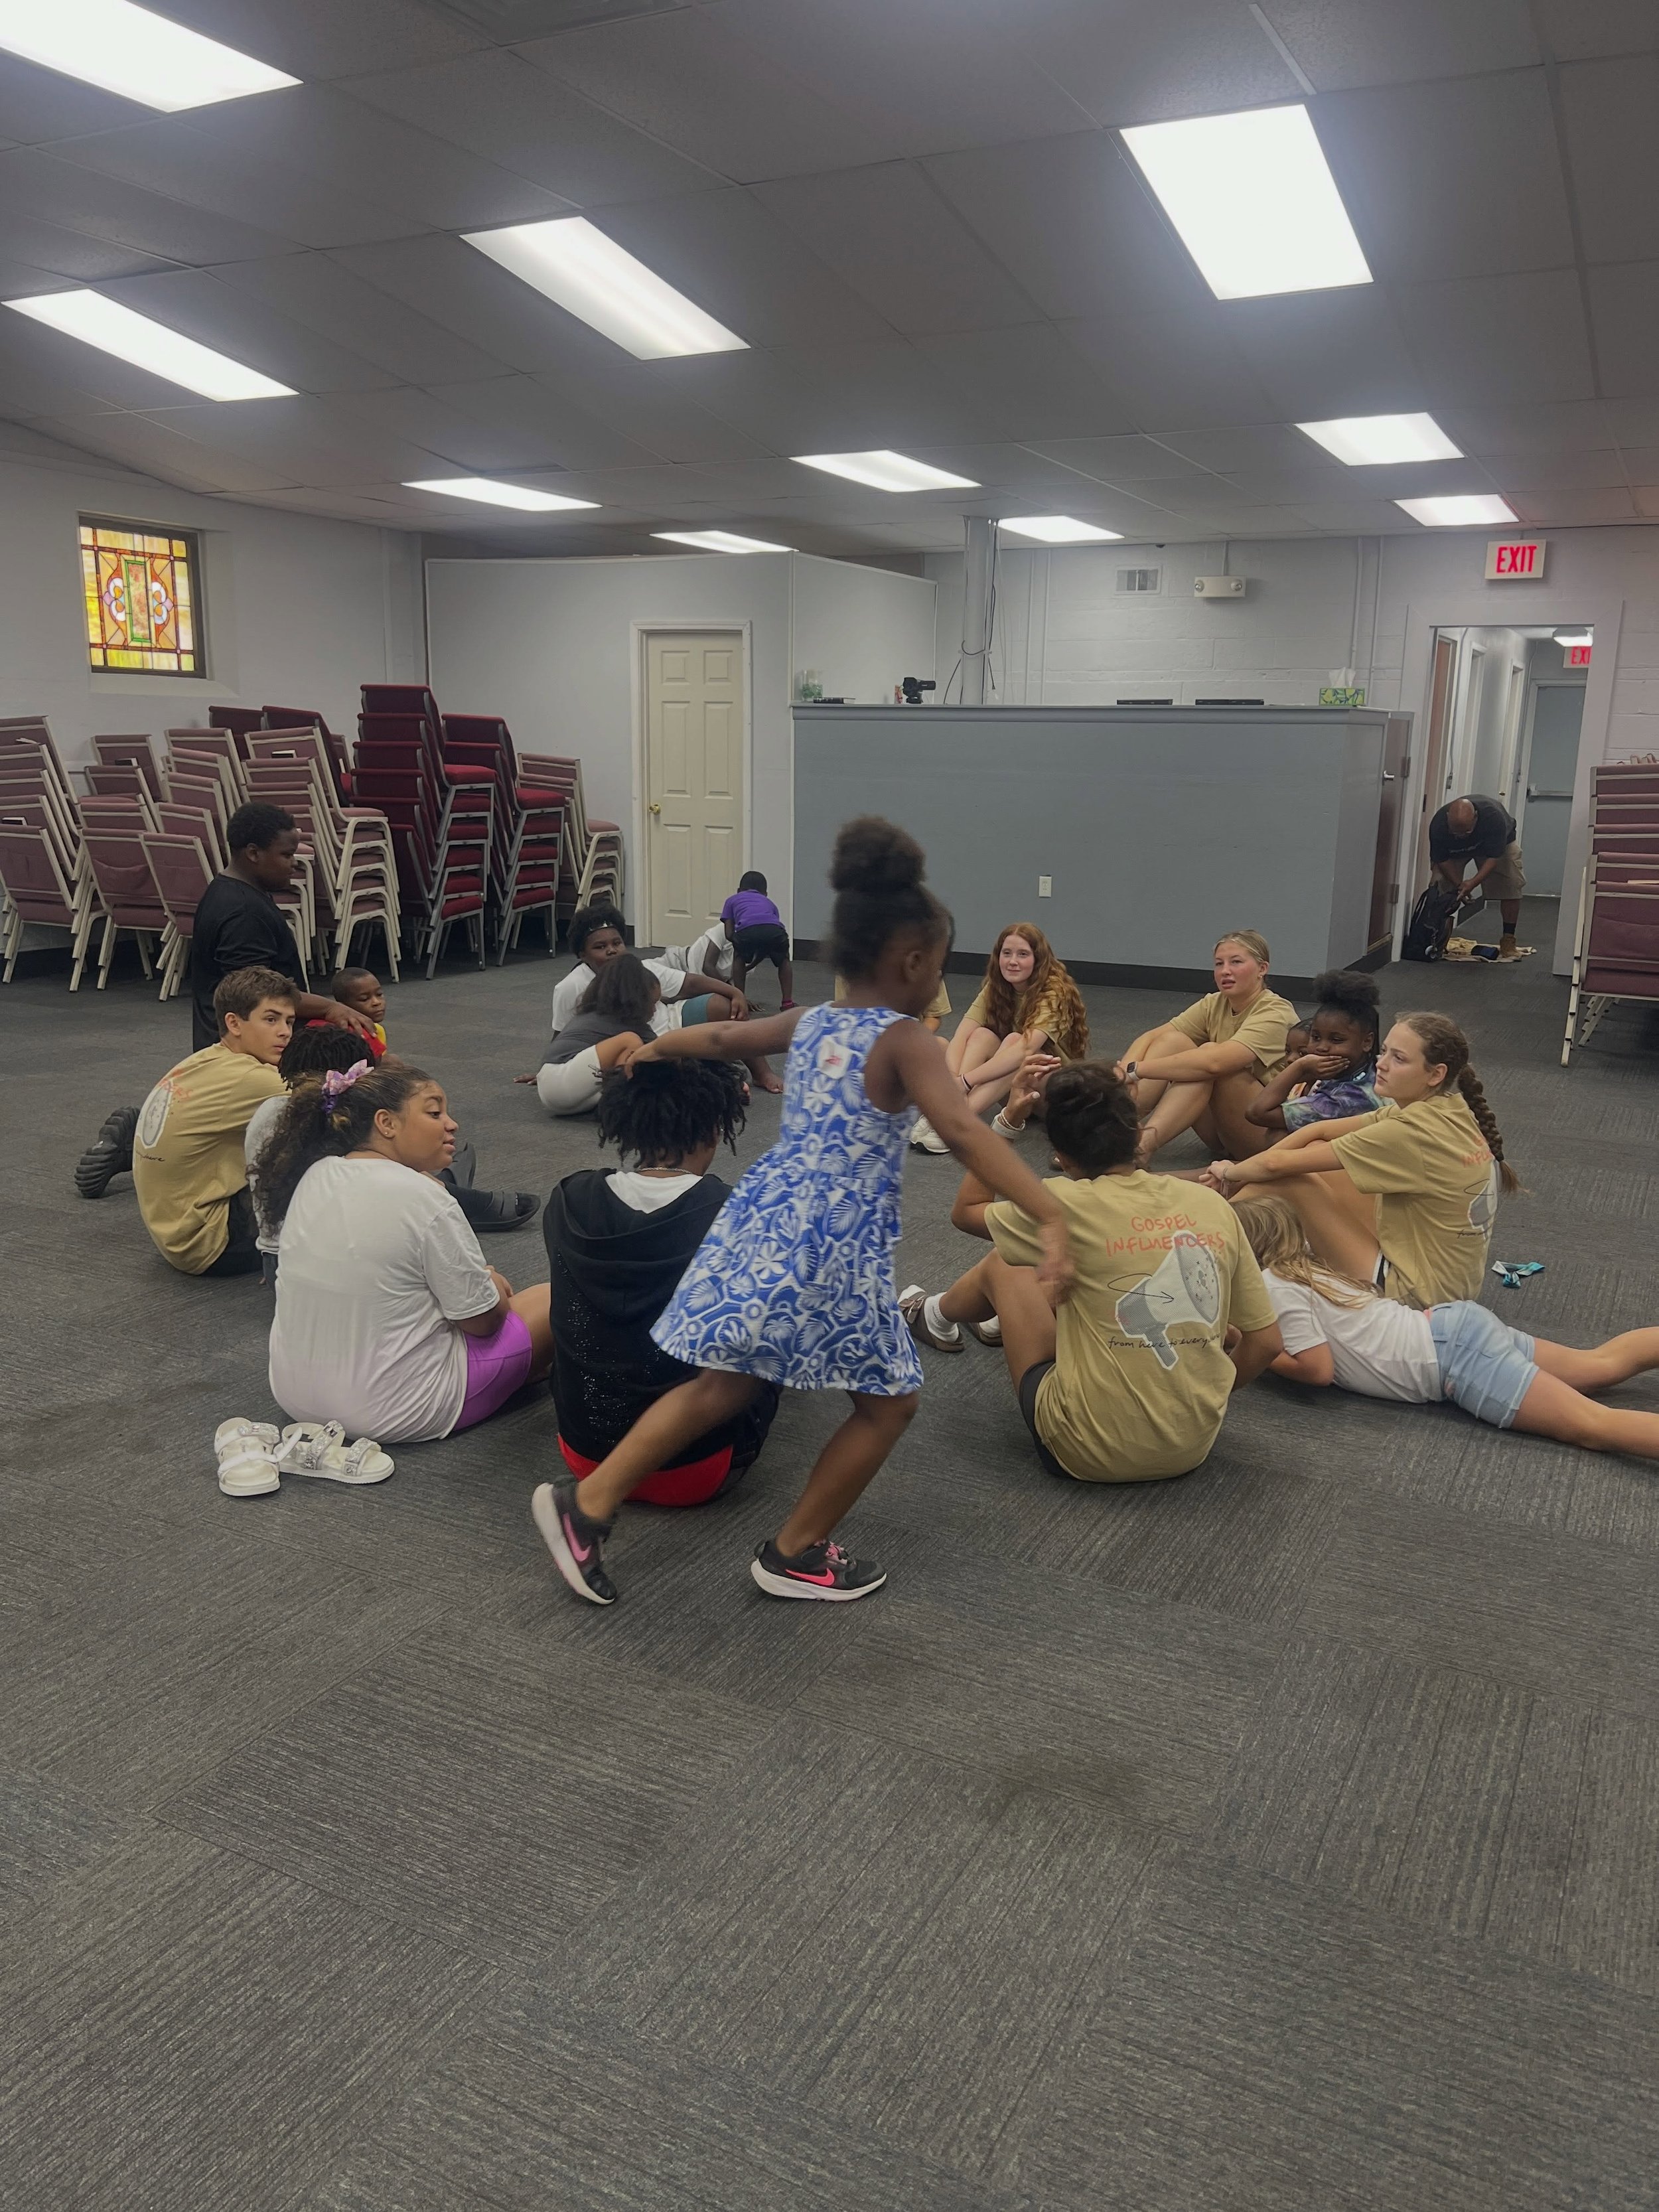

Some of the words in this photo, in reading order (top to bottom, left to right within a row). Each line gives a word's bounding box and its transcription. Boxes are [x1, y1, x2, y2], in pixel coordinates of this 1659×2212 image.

[1496, 545, 1538, 573] EXIT
[1571, 646, 1591, 664] EXI
[1131, 1213, 1197, 1232] GOSPEL
[1105, 1231, 1225, 1258] INFLUENCERS
[1108, 1335, 1134, 1349] from
[1138, 1340, 1166, 1349] here
[1168, 1338, 1177, 1349] to
